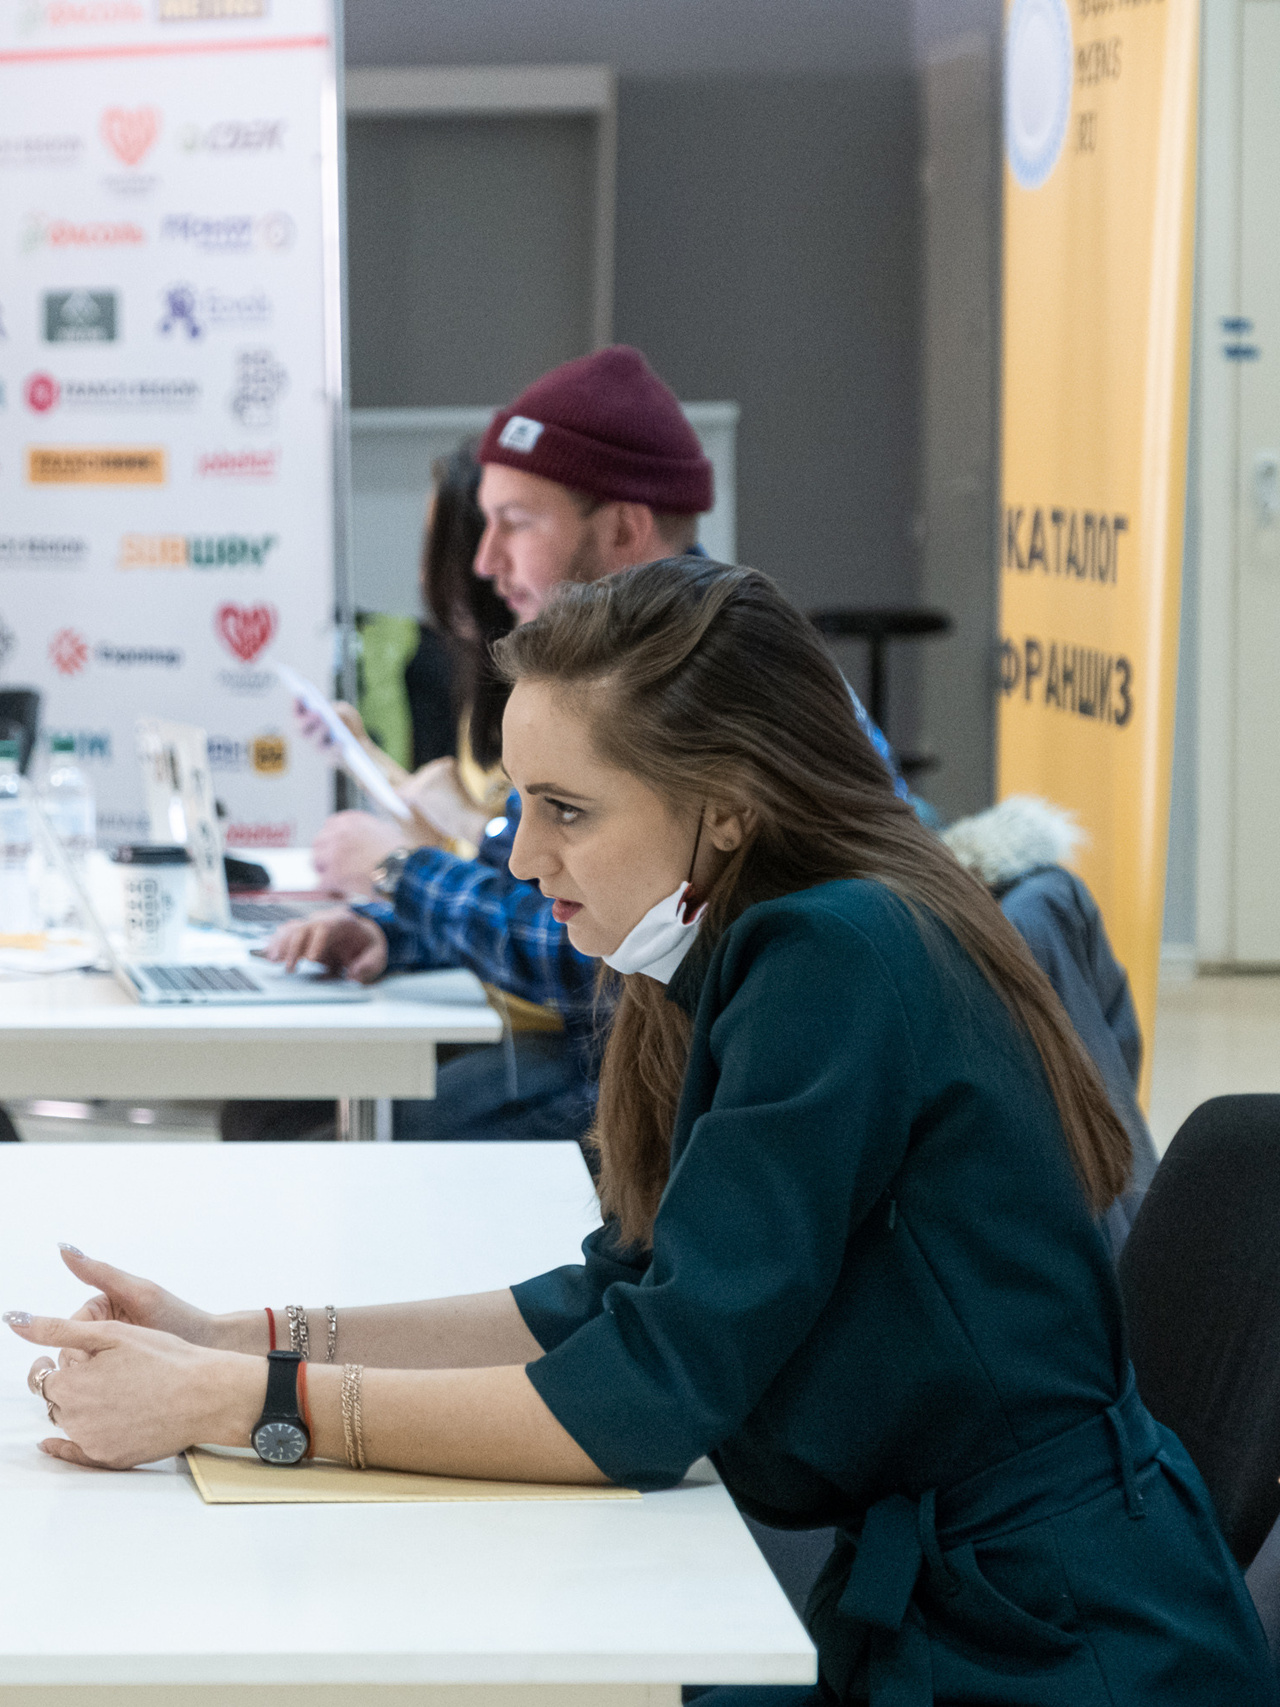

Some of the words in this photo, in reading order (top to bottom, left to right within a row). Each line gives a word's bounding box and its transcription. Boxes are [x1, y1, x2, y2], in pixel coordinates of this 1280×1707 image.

[121, 535, 274, 568] SUBWAY
[1005, 507, 1130, 588] КАТАЛОГ
[992, 637, 1133, 730] ФРАНШИЗ
